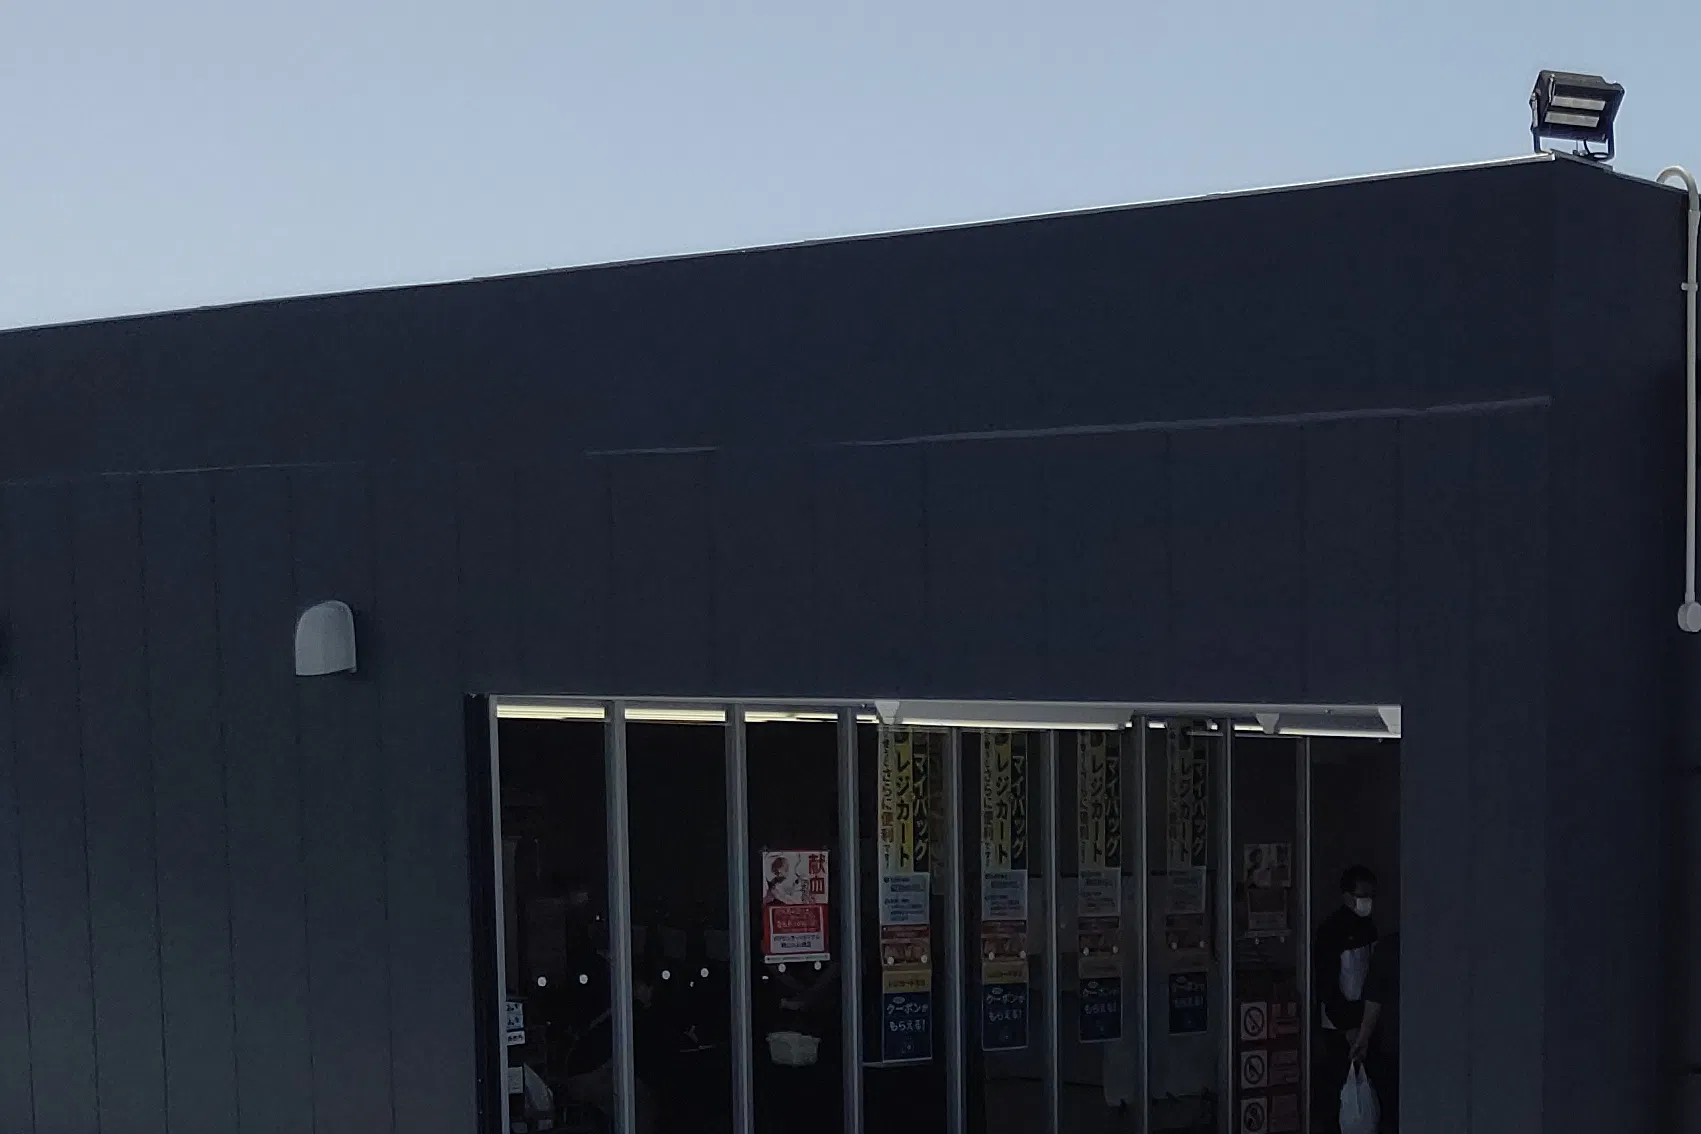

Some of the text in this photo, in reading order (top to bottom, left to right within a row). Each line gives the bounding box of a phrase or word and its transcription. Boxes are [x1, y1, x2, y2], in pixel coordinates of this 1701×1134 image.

[896, 752, 910, 868] レジカート
[913, 753, 929, 861] マイバッグ
[995, 752, 1009, 865] レジカート
[1011, 755, 1026, 859] マイバッグ
[808, 853, 826, 895] 献血
